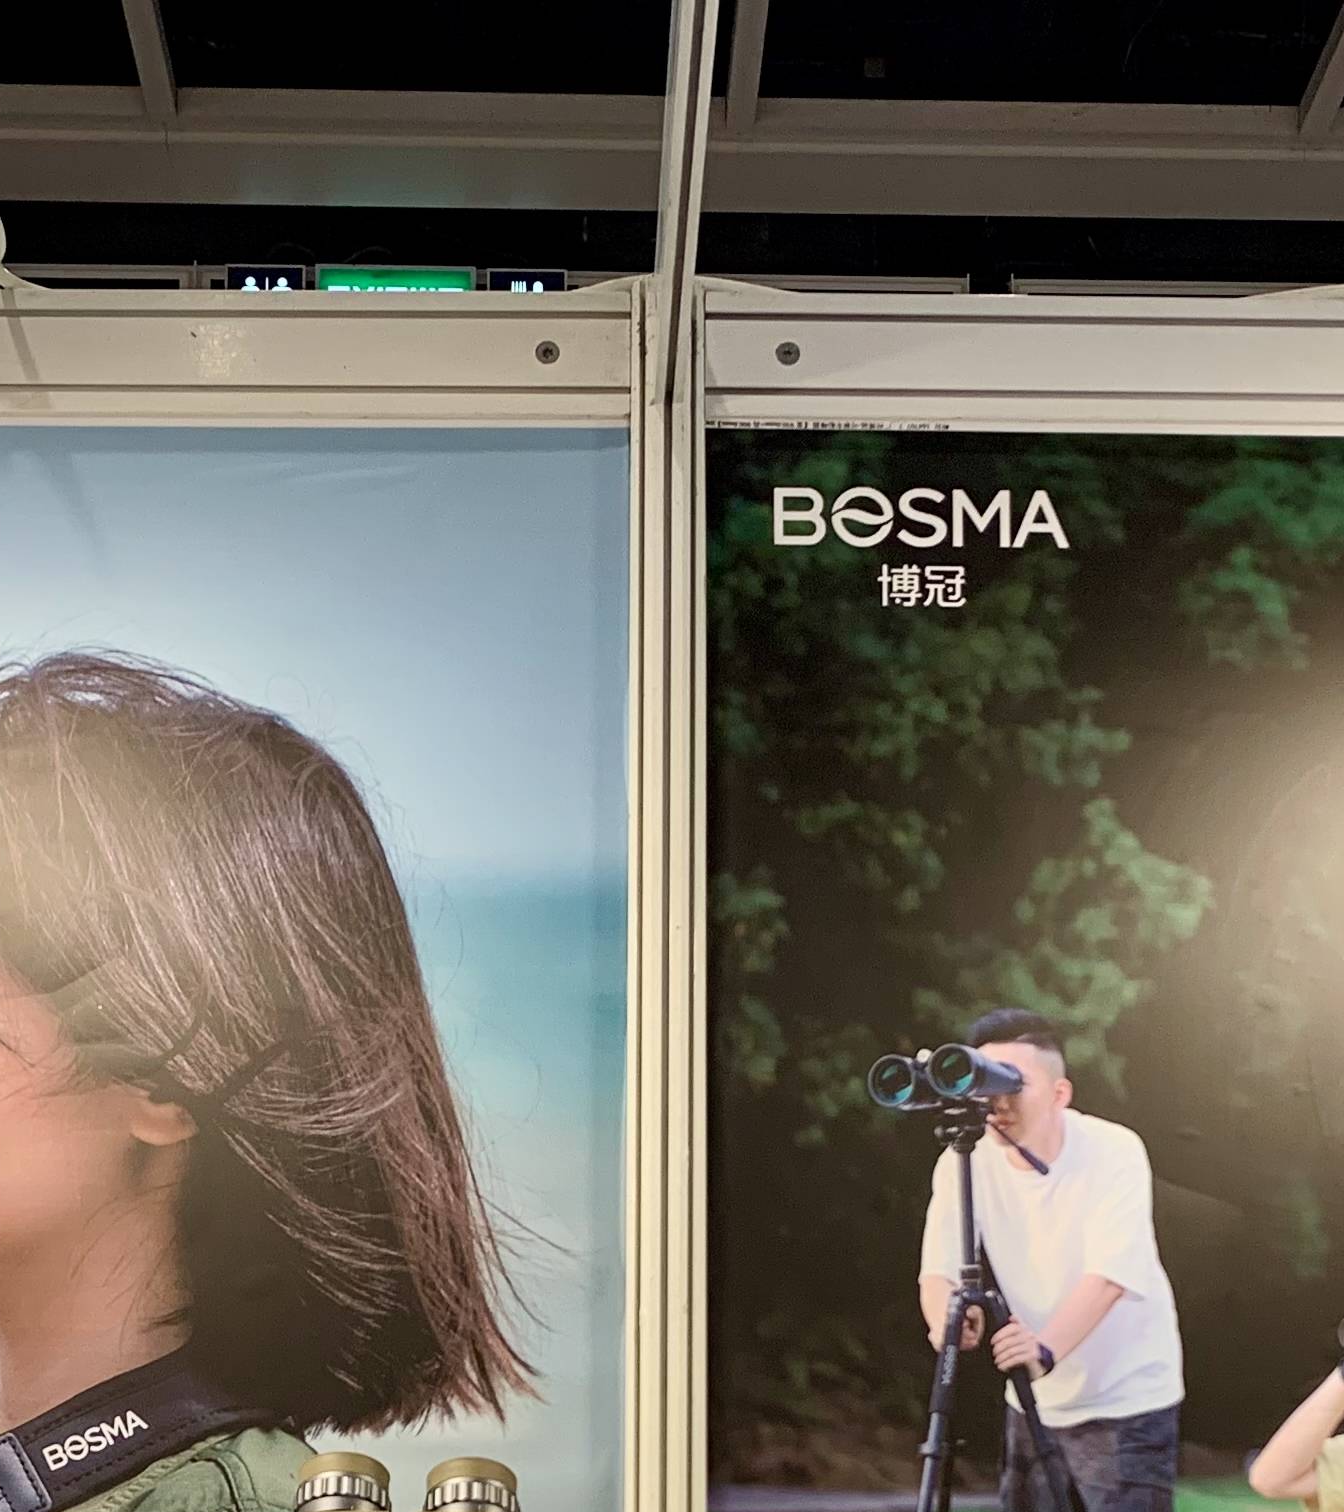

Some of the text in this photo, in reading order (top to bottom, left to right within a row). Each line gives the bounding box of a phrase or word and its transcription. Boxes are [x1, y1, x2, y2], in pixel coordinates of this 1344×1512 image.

[772, 486, 1071, 549] BOSMA
[877, 563, 967, 608] 博冠
[41, 1409, 150, 1472] BOSMA
